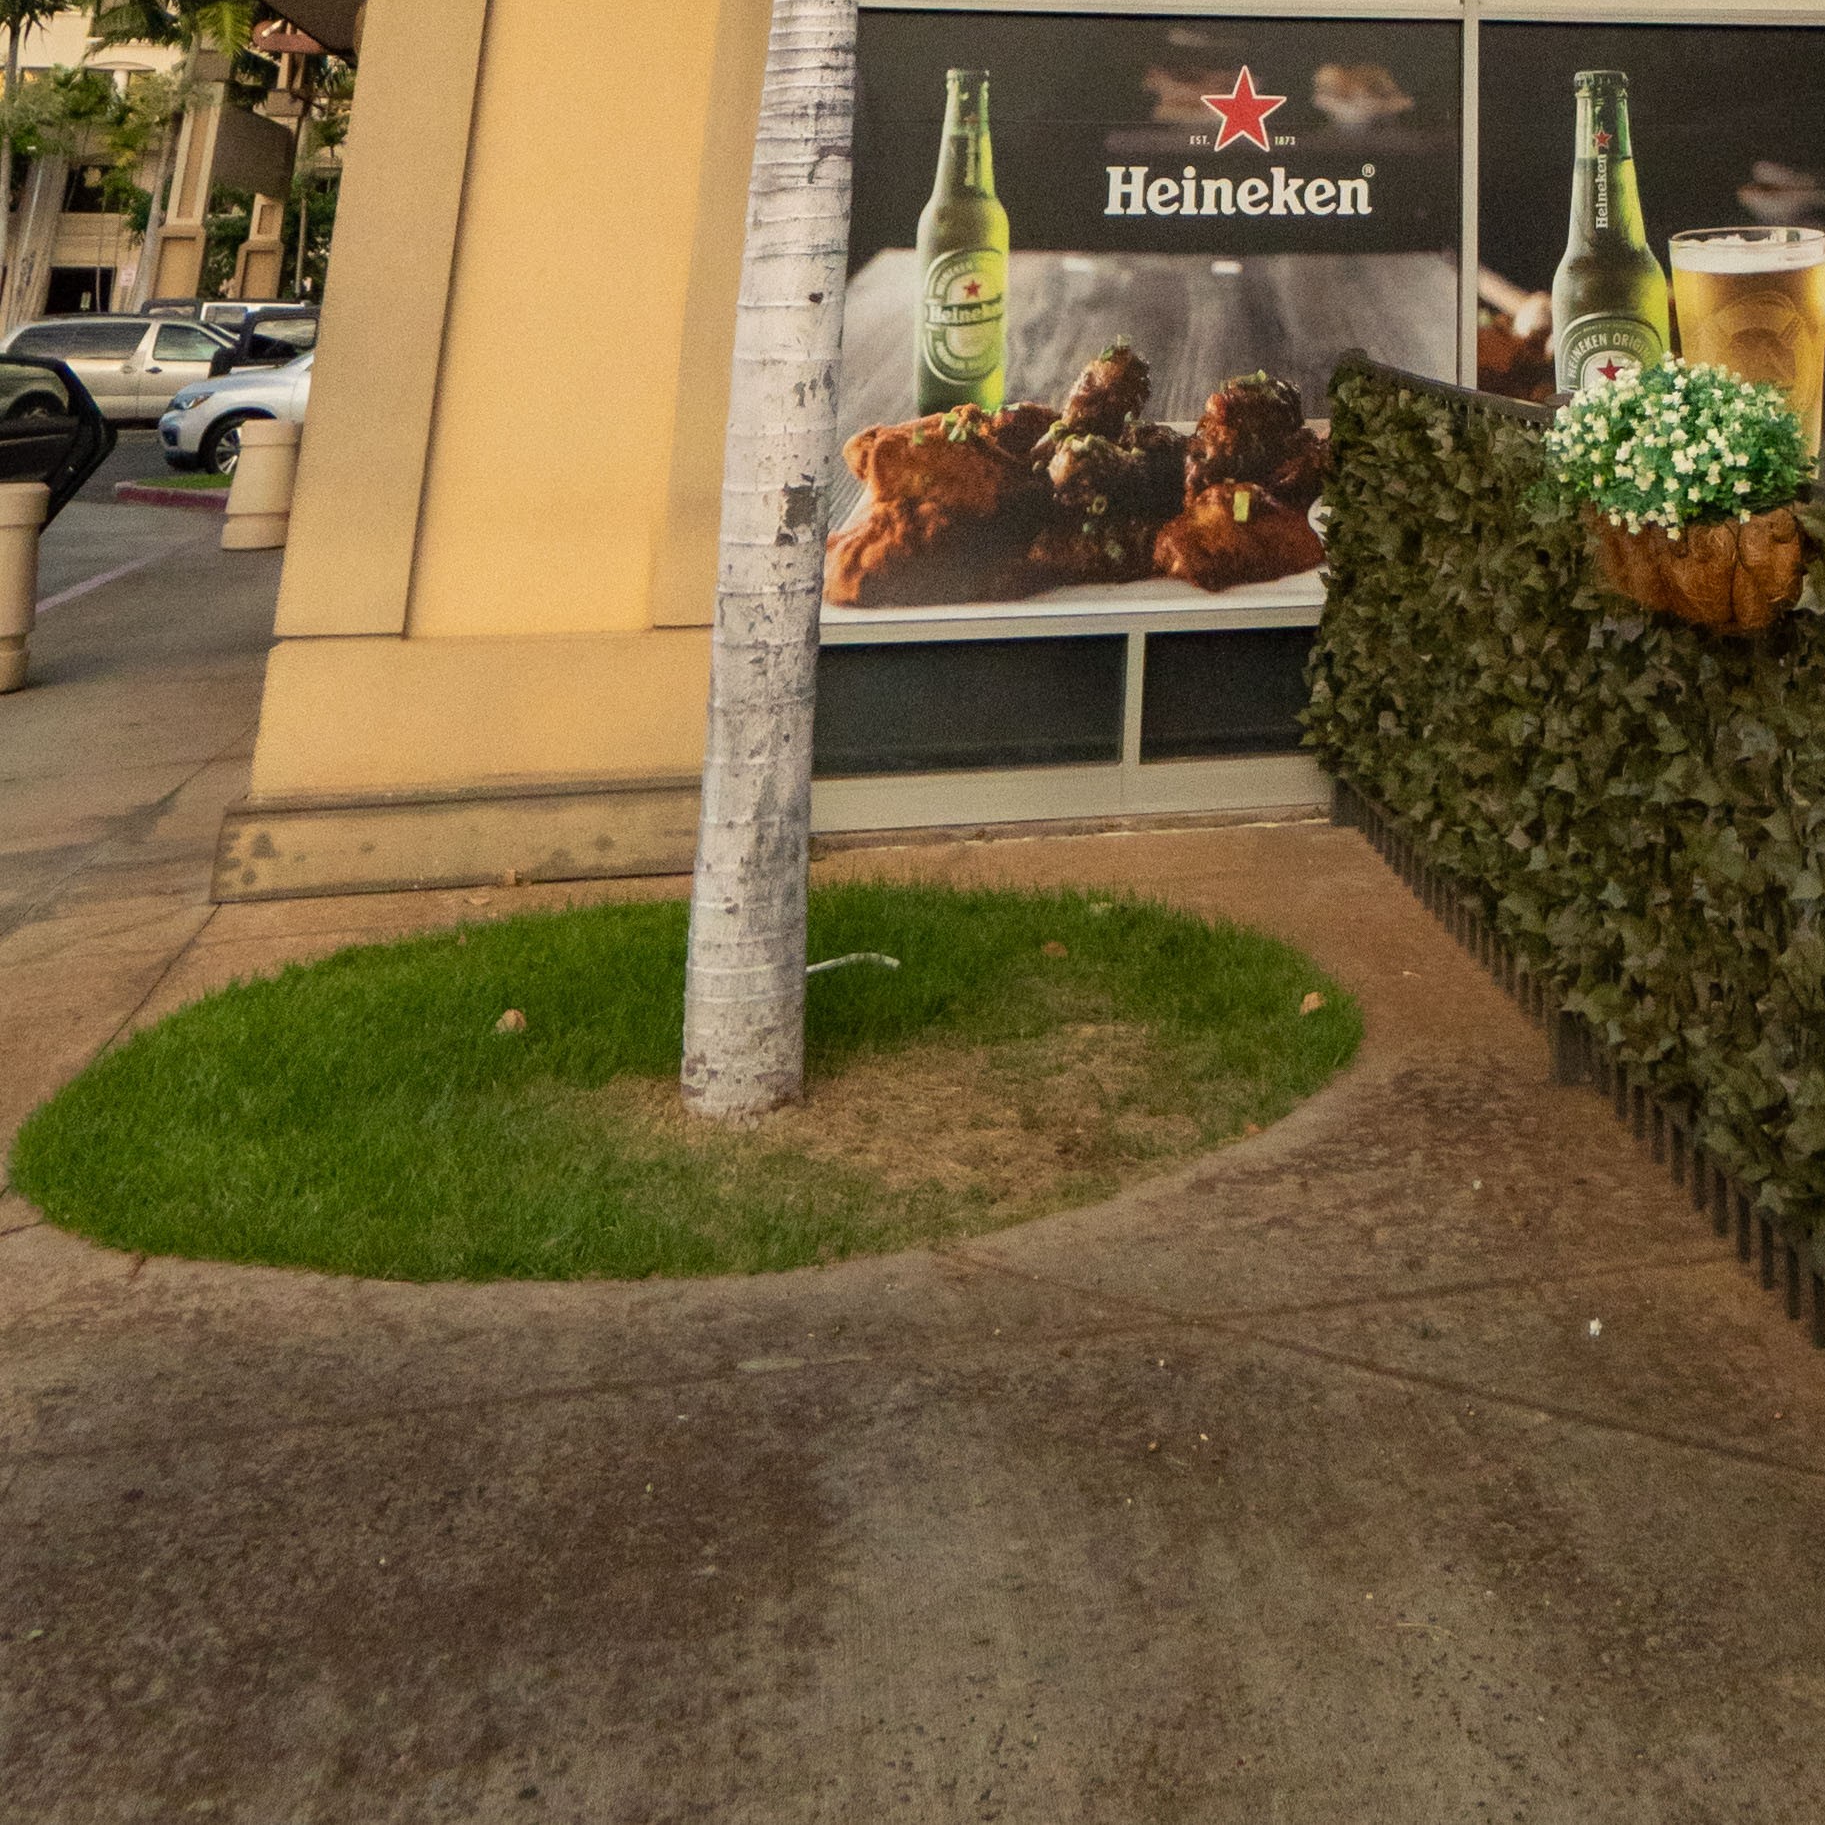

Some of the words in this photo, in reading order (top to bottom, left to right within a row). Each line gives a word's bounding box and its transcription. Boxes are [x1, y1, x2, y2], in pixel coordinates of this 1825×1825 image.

[1189, 135, 1210, 145] EST.
[1274, 135, 1296, 146] 1873
[1595, 154, 1608, 229] Heineken
